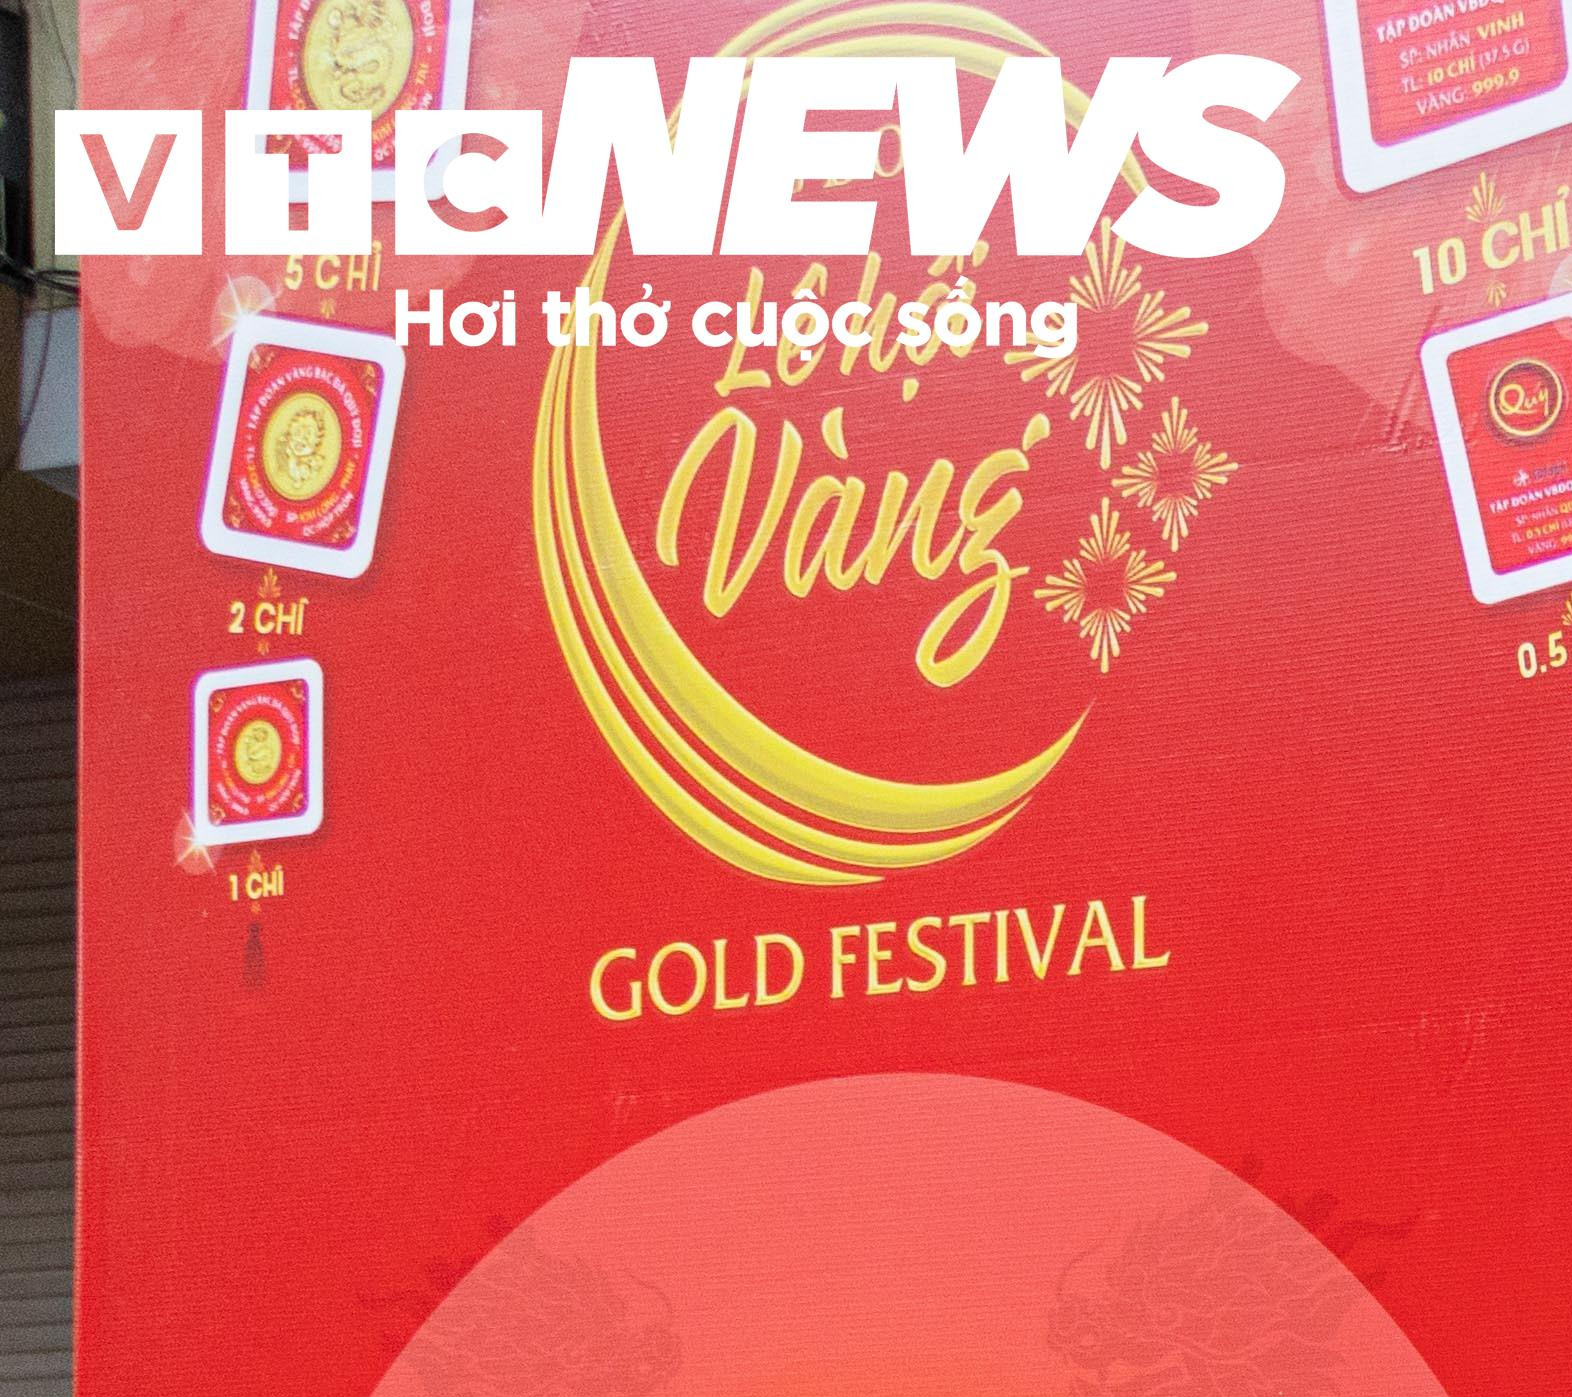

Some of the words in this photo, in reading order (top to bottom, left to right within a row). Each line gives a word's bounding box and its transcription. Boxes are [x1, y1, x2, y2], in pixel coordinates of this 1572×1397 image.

[1471, 67, 1521, 98] 999.9
[1413, 236, 1468, 297] 10
[1480, 183, 1572, 271] CHỈ
[655, 405, 1052, 689] Vàng
[228, 602, 245, 637] 2
[252, 596, 309, 638] CHỈ
[1516, 629, 1569, 681] 0.5
[228, 872, 238, 902] 1
[246, 866, 285, 900] CHỈ
[588, 929, 805, 1025] GOLD
[829, 892, 1173, 1002] FESTIVAL
